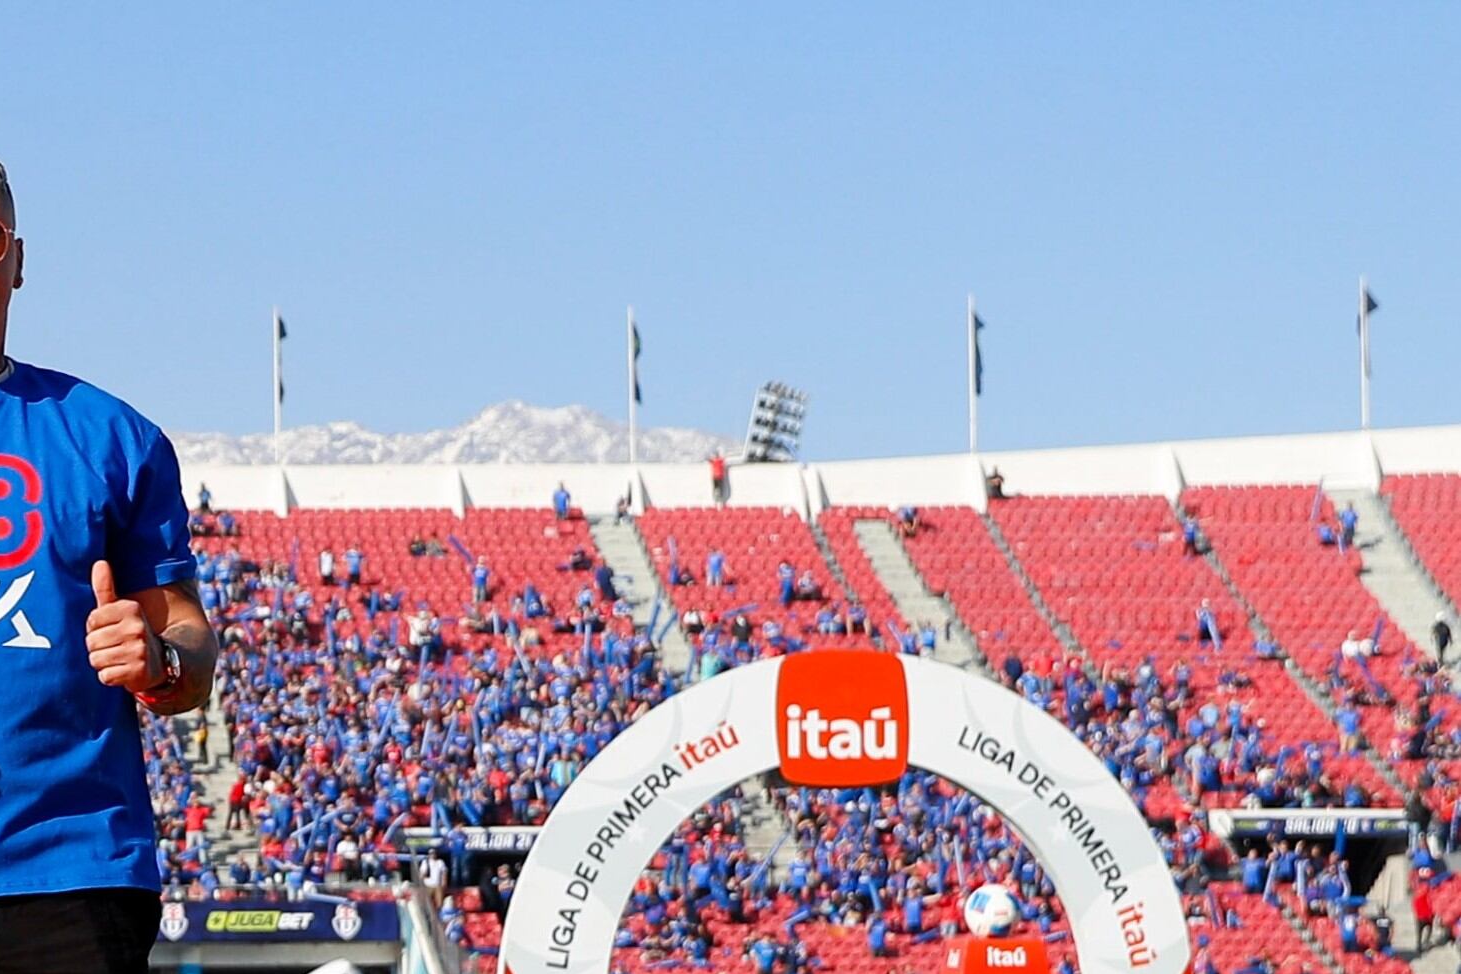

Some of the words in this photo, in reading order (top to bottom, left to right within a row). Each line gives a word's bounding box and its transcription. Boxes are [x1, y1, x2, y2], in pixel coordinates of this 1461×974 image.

[786, 703, 898, 760] itaú
[546, 907, 582, 970] LIGA
[566, 861, 599, 901] DE
[586, 762, 682, 864] PRIMERA
[673, 720, 741, 770] itaú
[957, 725, 1016, 774] LIGA
[1017, 762, 1056, 800] DE
[1049, 791, 1129, 905] PRIMERA
[1116, 901, 1158, 969] itaú
[986, 945, 1027, 968] itaú
